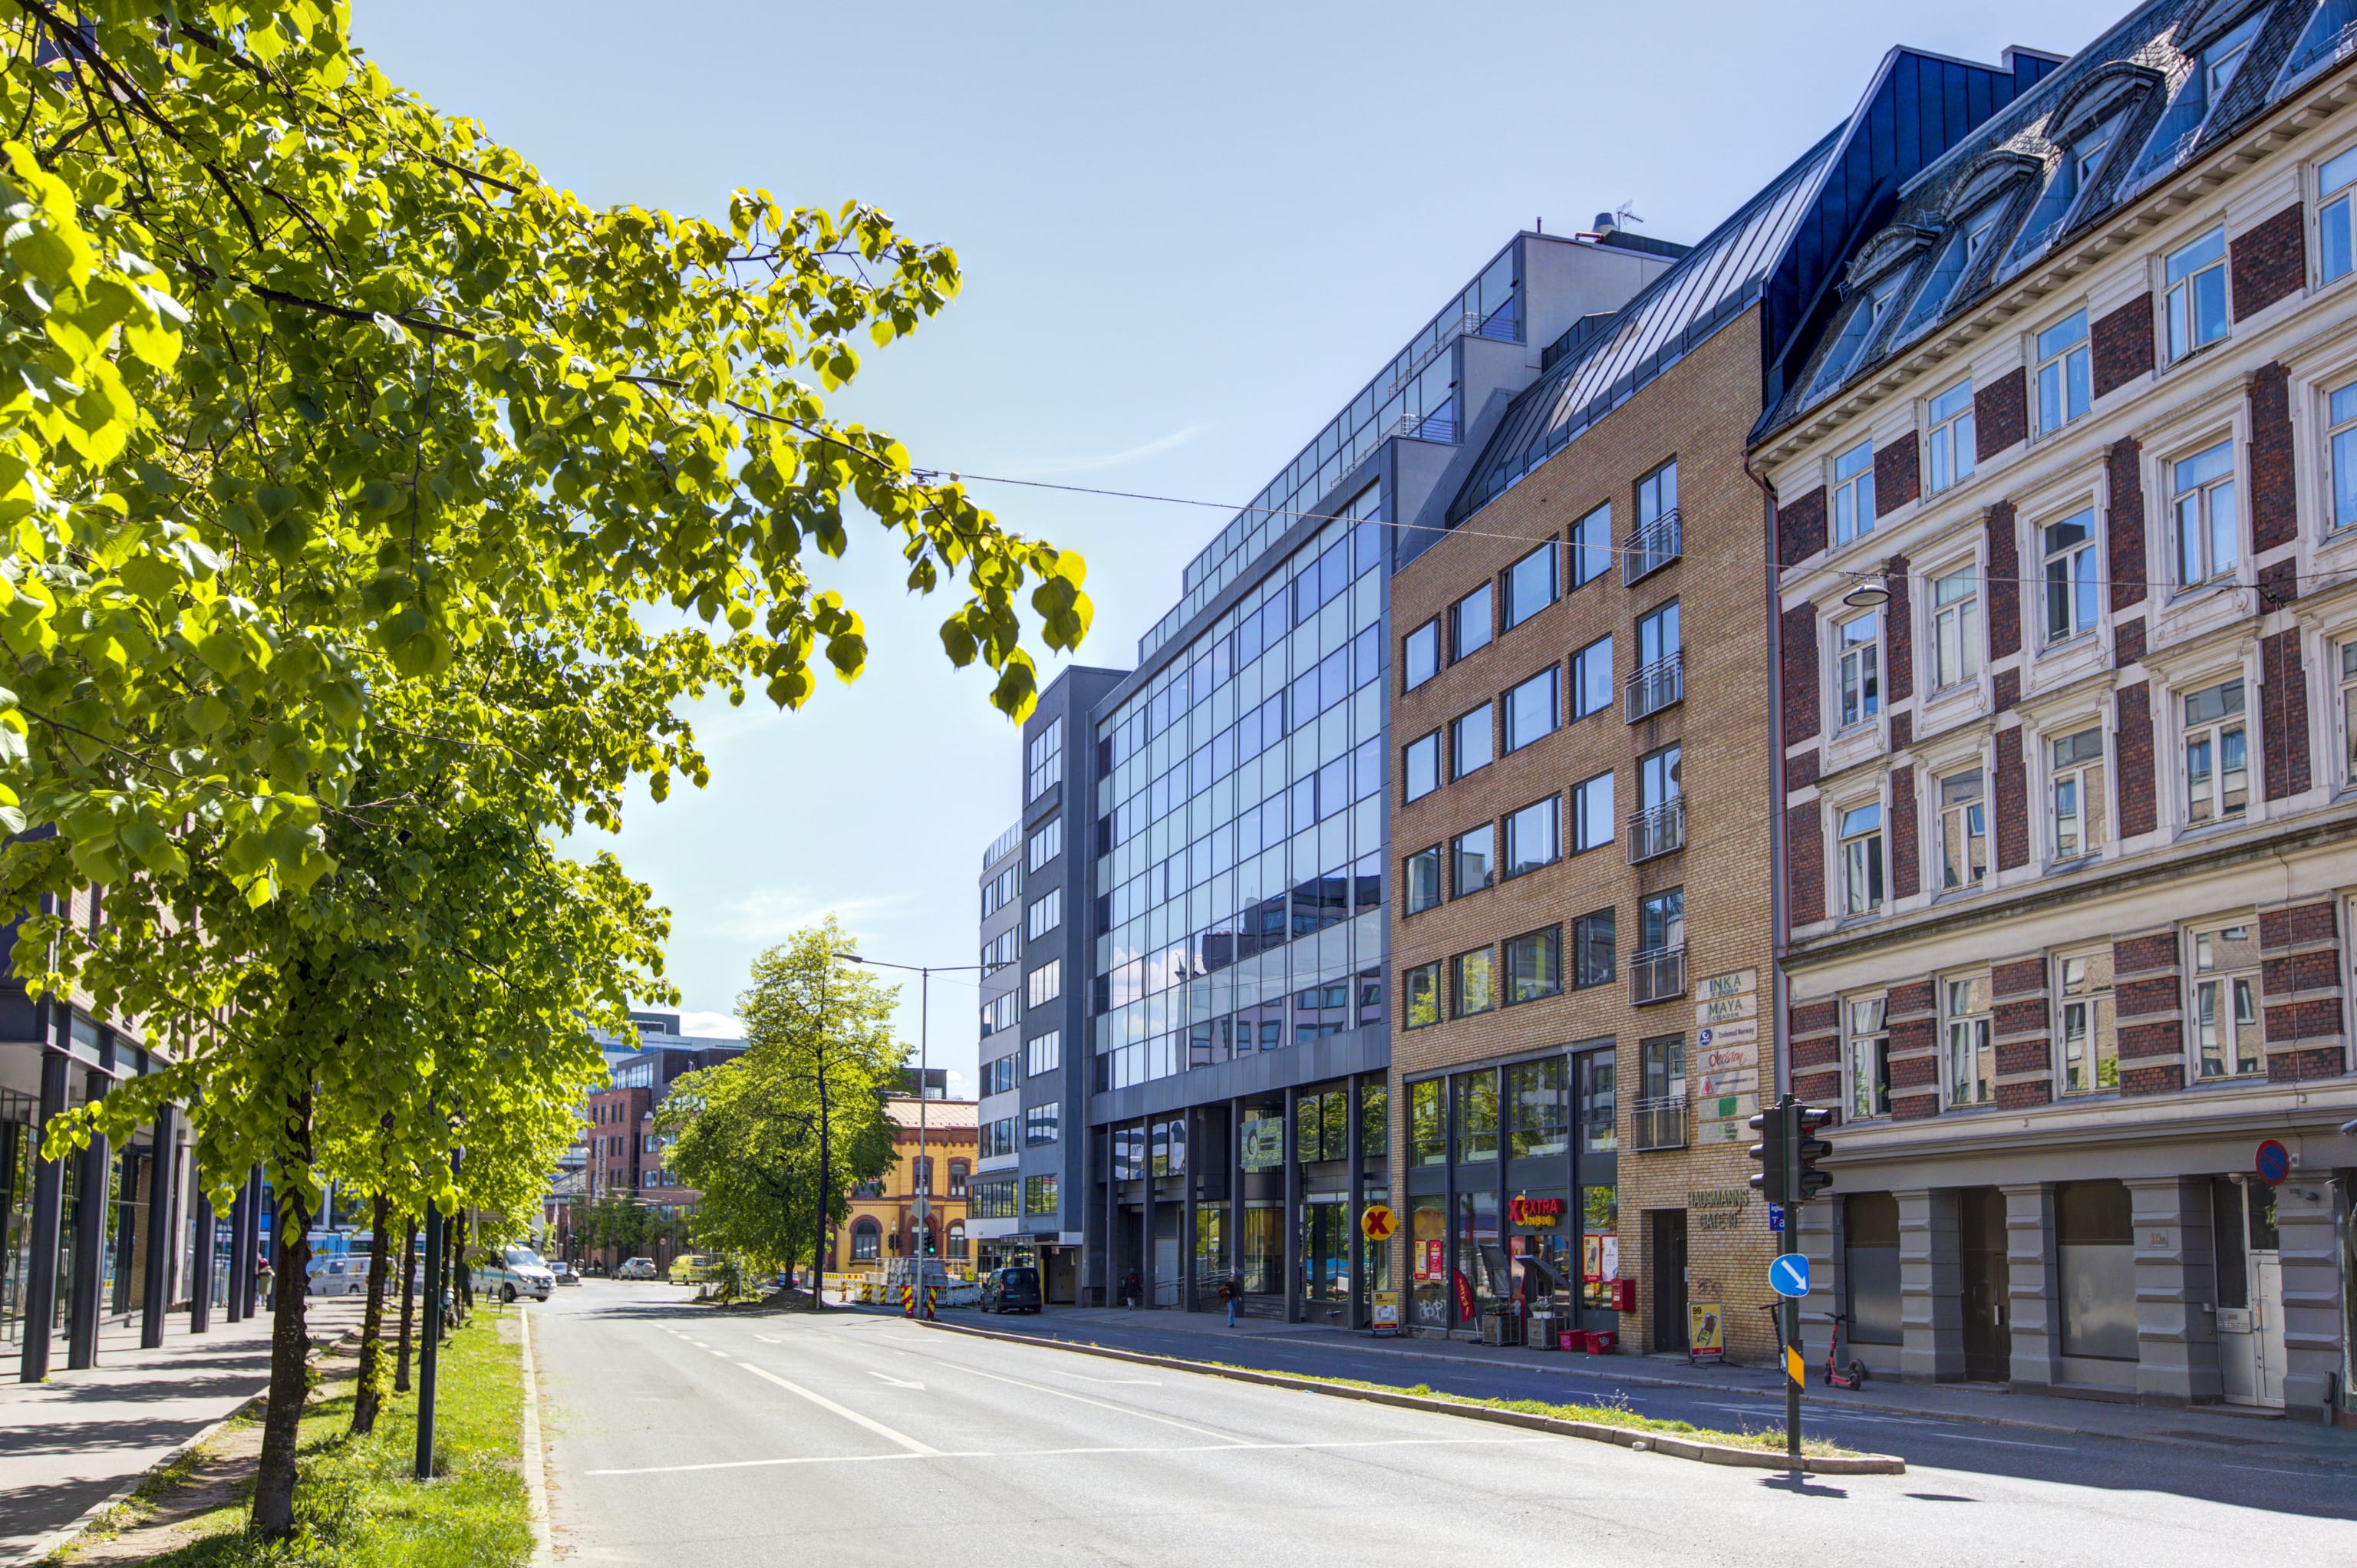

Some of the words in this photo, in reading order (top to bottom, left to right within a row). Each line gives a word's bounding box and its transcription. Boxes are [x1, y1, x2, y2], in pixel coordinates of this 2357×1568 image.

[1709, 974, 1742, 992] INKA
[1709, 999, 1742, 1015] MAYA
[1524, 1198, 1558, 1214] EXTRA
[1687, 1189, 1749, 1208] HAUSMANNS
[1699, 1212, 1726, 1230] GATE
[1771, 1216, 1785, 1227] Ta
[1693, 1306, 1703, 1315] 99
